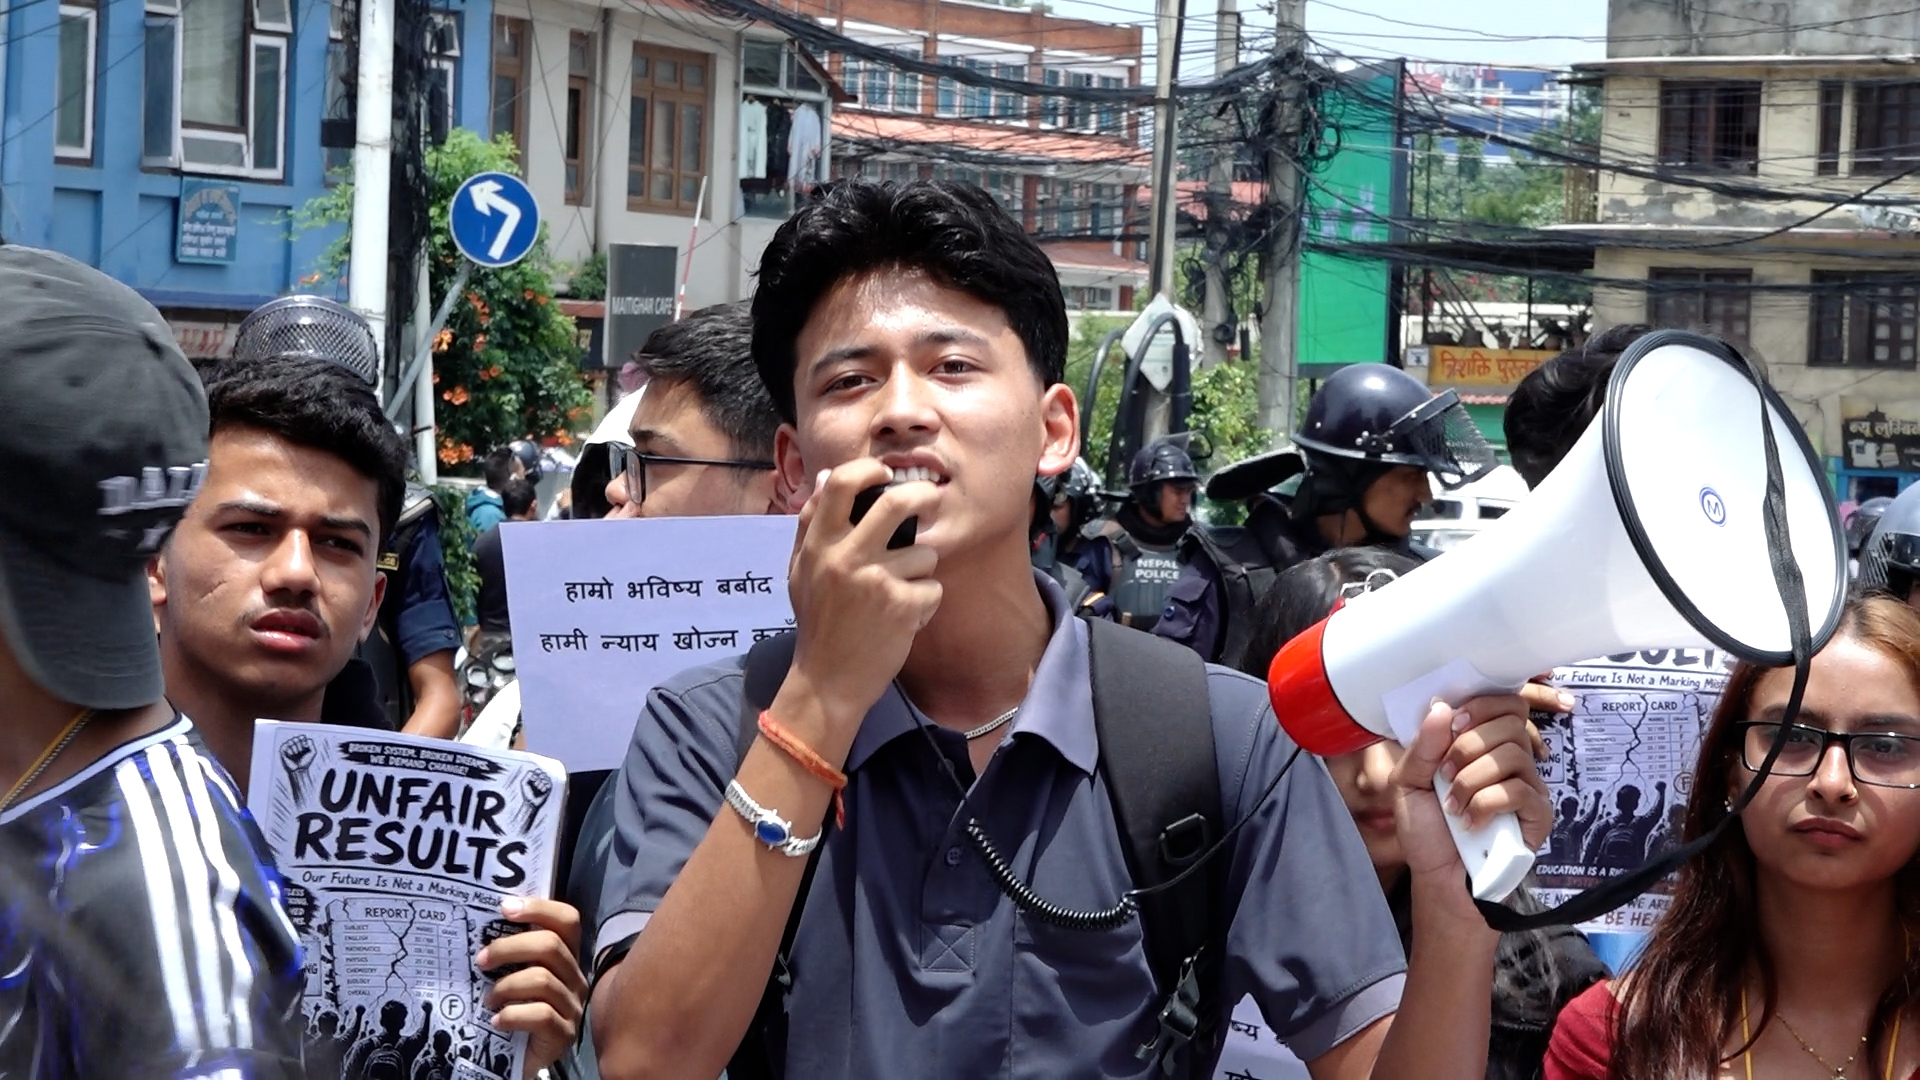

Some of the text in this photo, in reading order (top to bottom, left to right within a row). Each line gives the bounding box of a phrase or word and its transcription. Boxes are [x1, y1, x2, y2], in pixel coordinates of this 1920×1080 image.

[1137, 558, 1179, 569] NEPAL
[1135, 569, 1180, 580] POLICE
[565, 571, 773, 603] हाम्रो भविष्य बर्बाद
[540, 628, 588, 653] हामी
[600, 633, 659, 652] न्याय
[673, 626, 738, 650] खोज्न
[1571, 671, 1607, 683] Future
[1611, 672, 1622, 684] Is
[1627, 673, 1645, 685] Not
[1649, 677, 1656, 685] a
[1659, 675, 1700, 689] Marking
[1703, 677, 1725, 689] Mist
[1602, 701, 1678, 712] REPORT CARD
[348, 742, 382, 754] BROKEN
[419, 750, 454, 762] BROKEN
[370, 755, 385, 764] WE
[388, 756, 427, 768] DEMAND
[319, 768, 506, 836] UNFAIR
[294, 811, 528, 888] RESULTS
[1536, 864, 1585, 876] EDUCATION
[1587, 866, 1597, 876] IS
[1599, 867, 1606, 877] A
[302, 870, 326, 883] Our
[330, 871, 370, 886] Future
[375, 874, 388, 888] Is
[392, 877, 413, 891] Not
[416, 882, 424, 892] a
[428, 881, 470, 903] Marking
[365, 907, 446, 921] REPORT CARD
[1605, 911, 1626, 925] BE
[449, 999, 459, 1015] F
